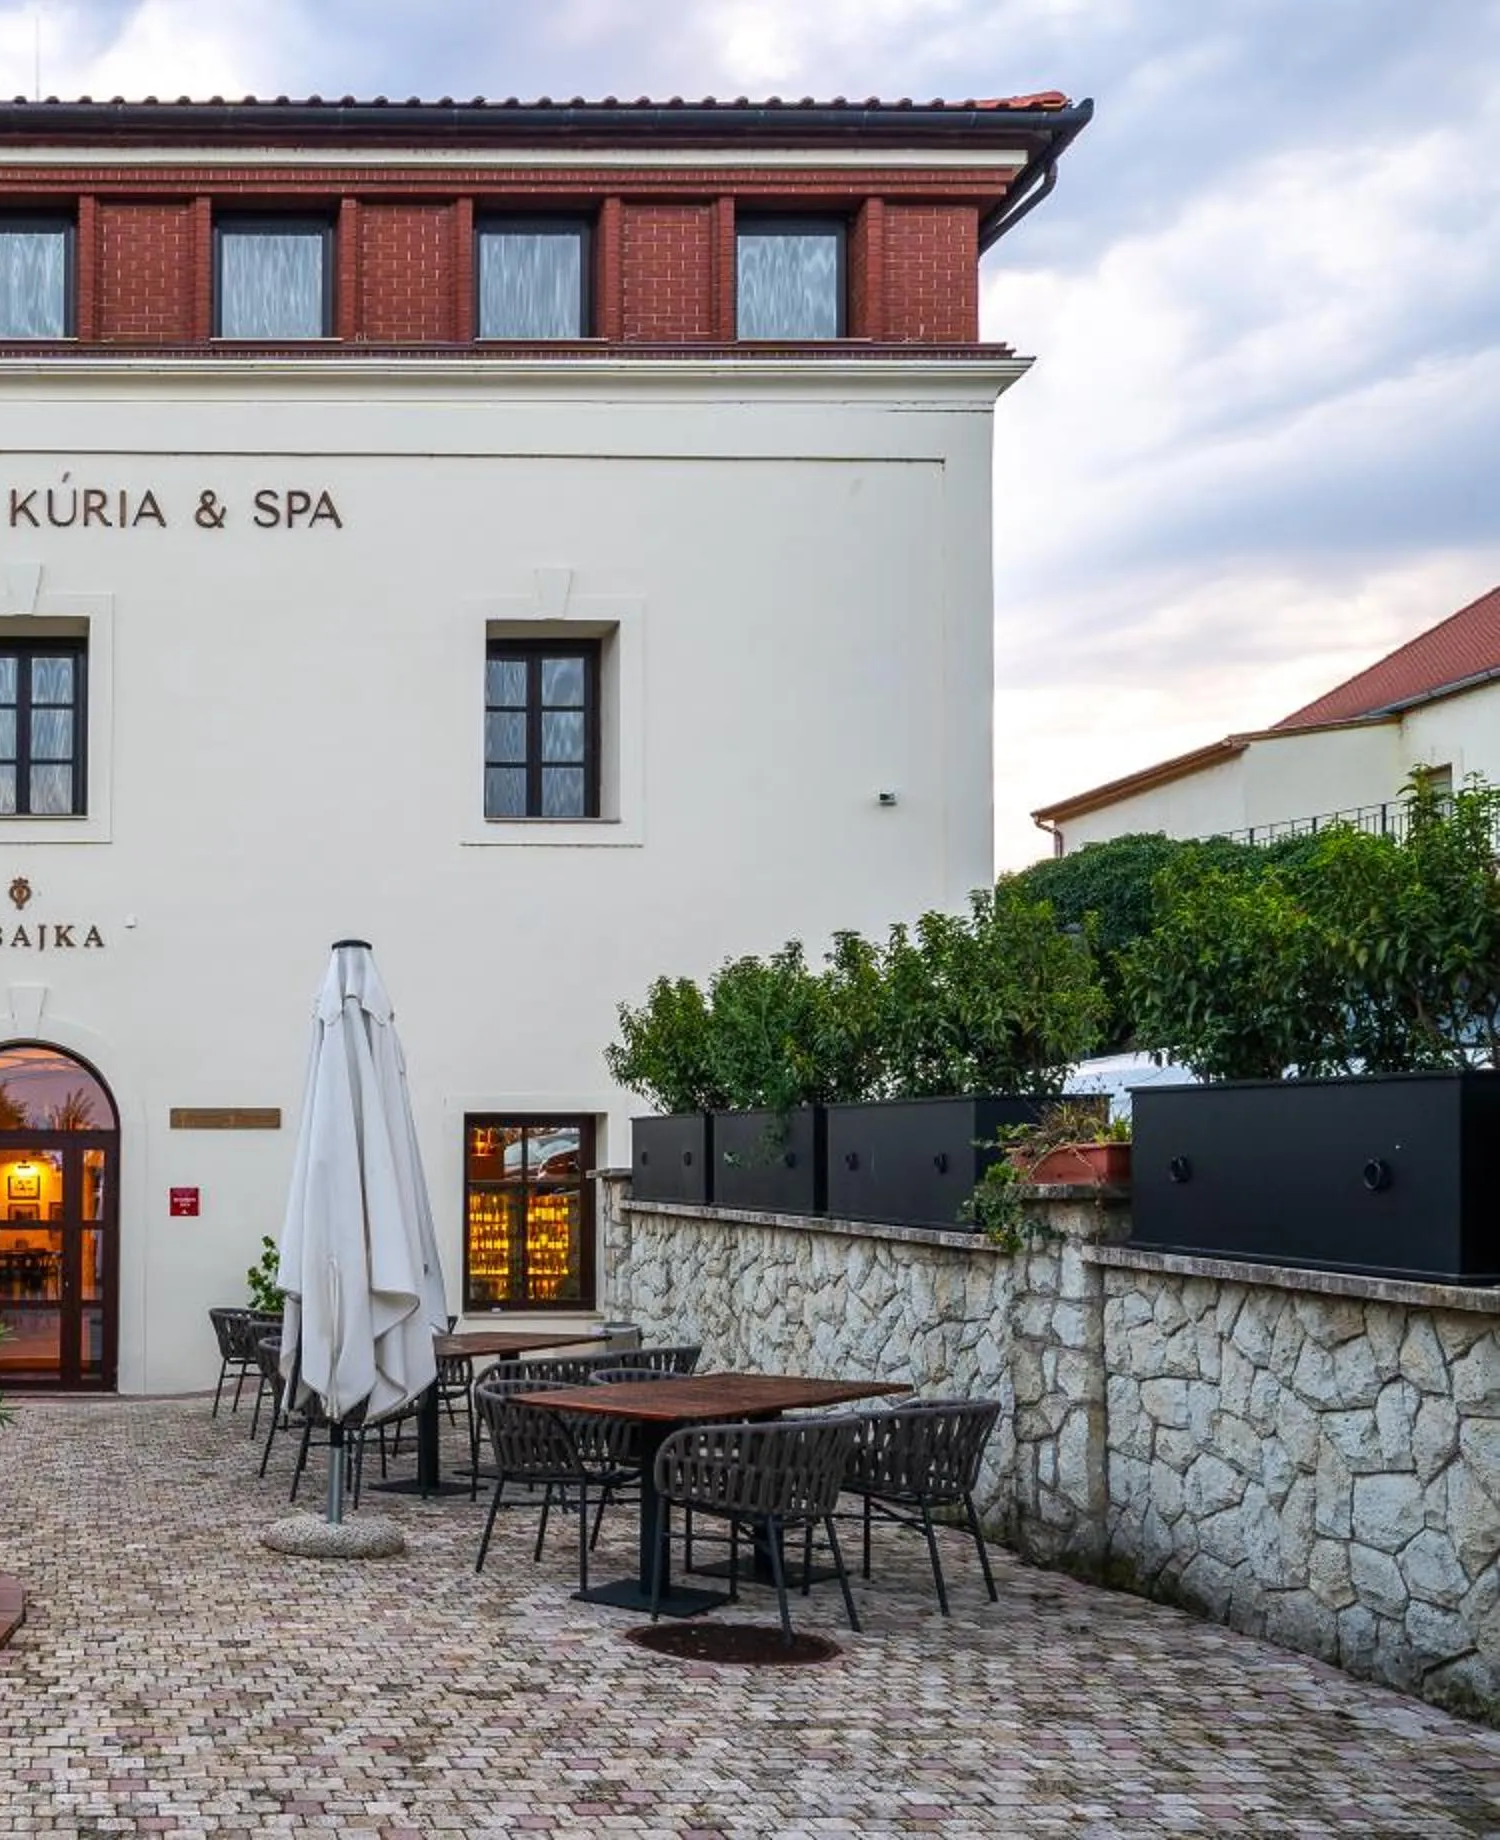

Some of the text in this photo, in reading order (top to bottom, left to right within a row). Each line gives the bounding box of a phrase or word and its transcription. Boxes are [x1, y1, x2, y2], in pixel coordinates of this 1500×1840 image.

[8, 471, 167, 529] KÚRIA
[193, 488, 227, 529] &
[252, 489, 343, 529] SPA
